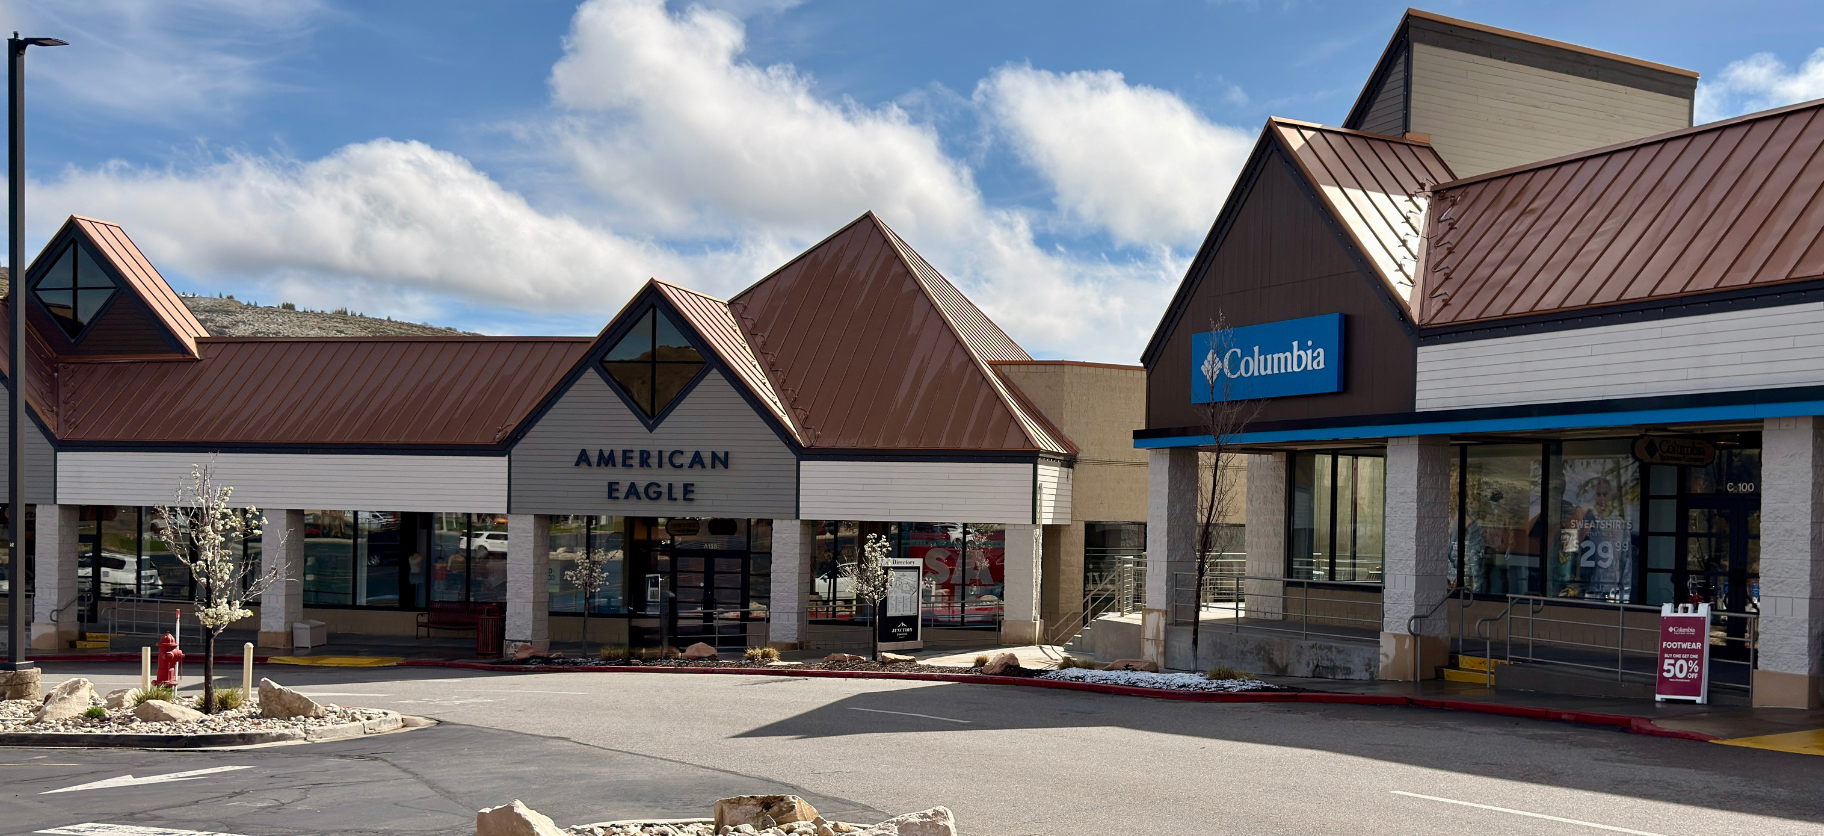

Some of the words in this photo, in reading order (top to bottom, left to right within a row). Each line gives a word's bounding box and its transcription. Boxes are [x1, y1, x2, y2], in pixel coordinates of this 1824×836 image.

[1223, 340, 1325, 379] Columbia
[574, 449, 729, 469] AMERICAN
[607, 482, 695, 501] EAGLE
[1570, 519, 1633, 529] SWEATSHIRTS
[892, 559, 915, 567] Directory
[1662, 659, 1699, 678] 50%
